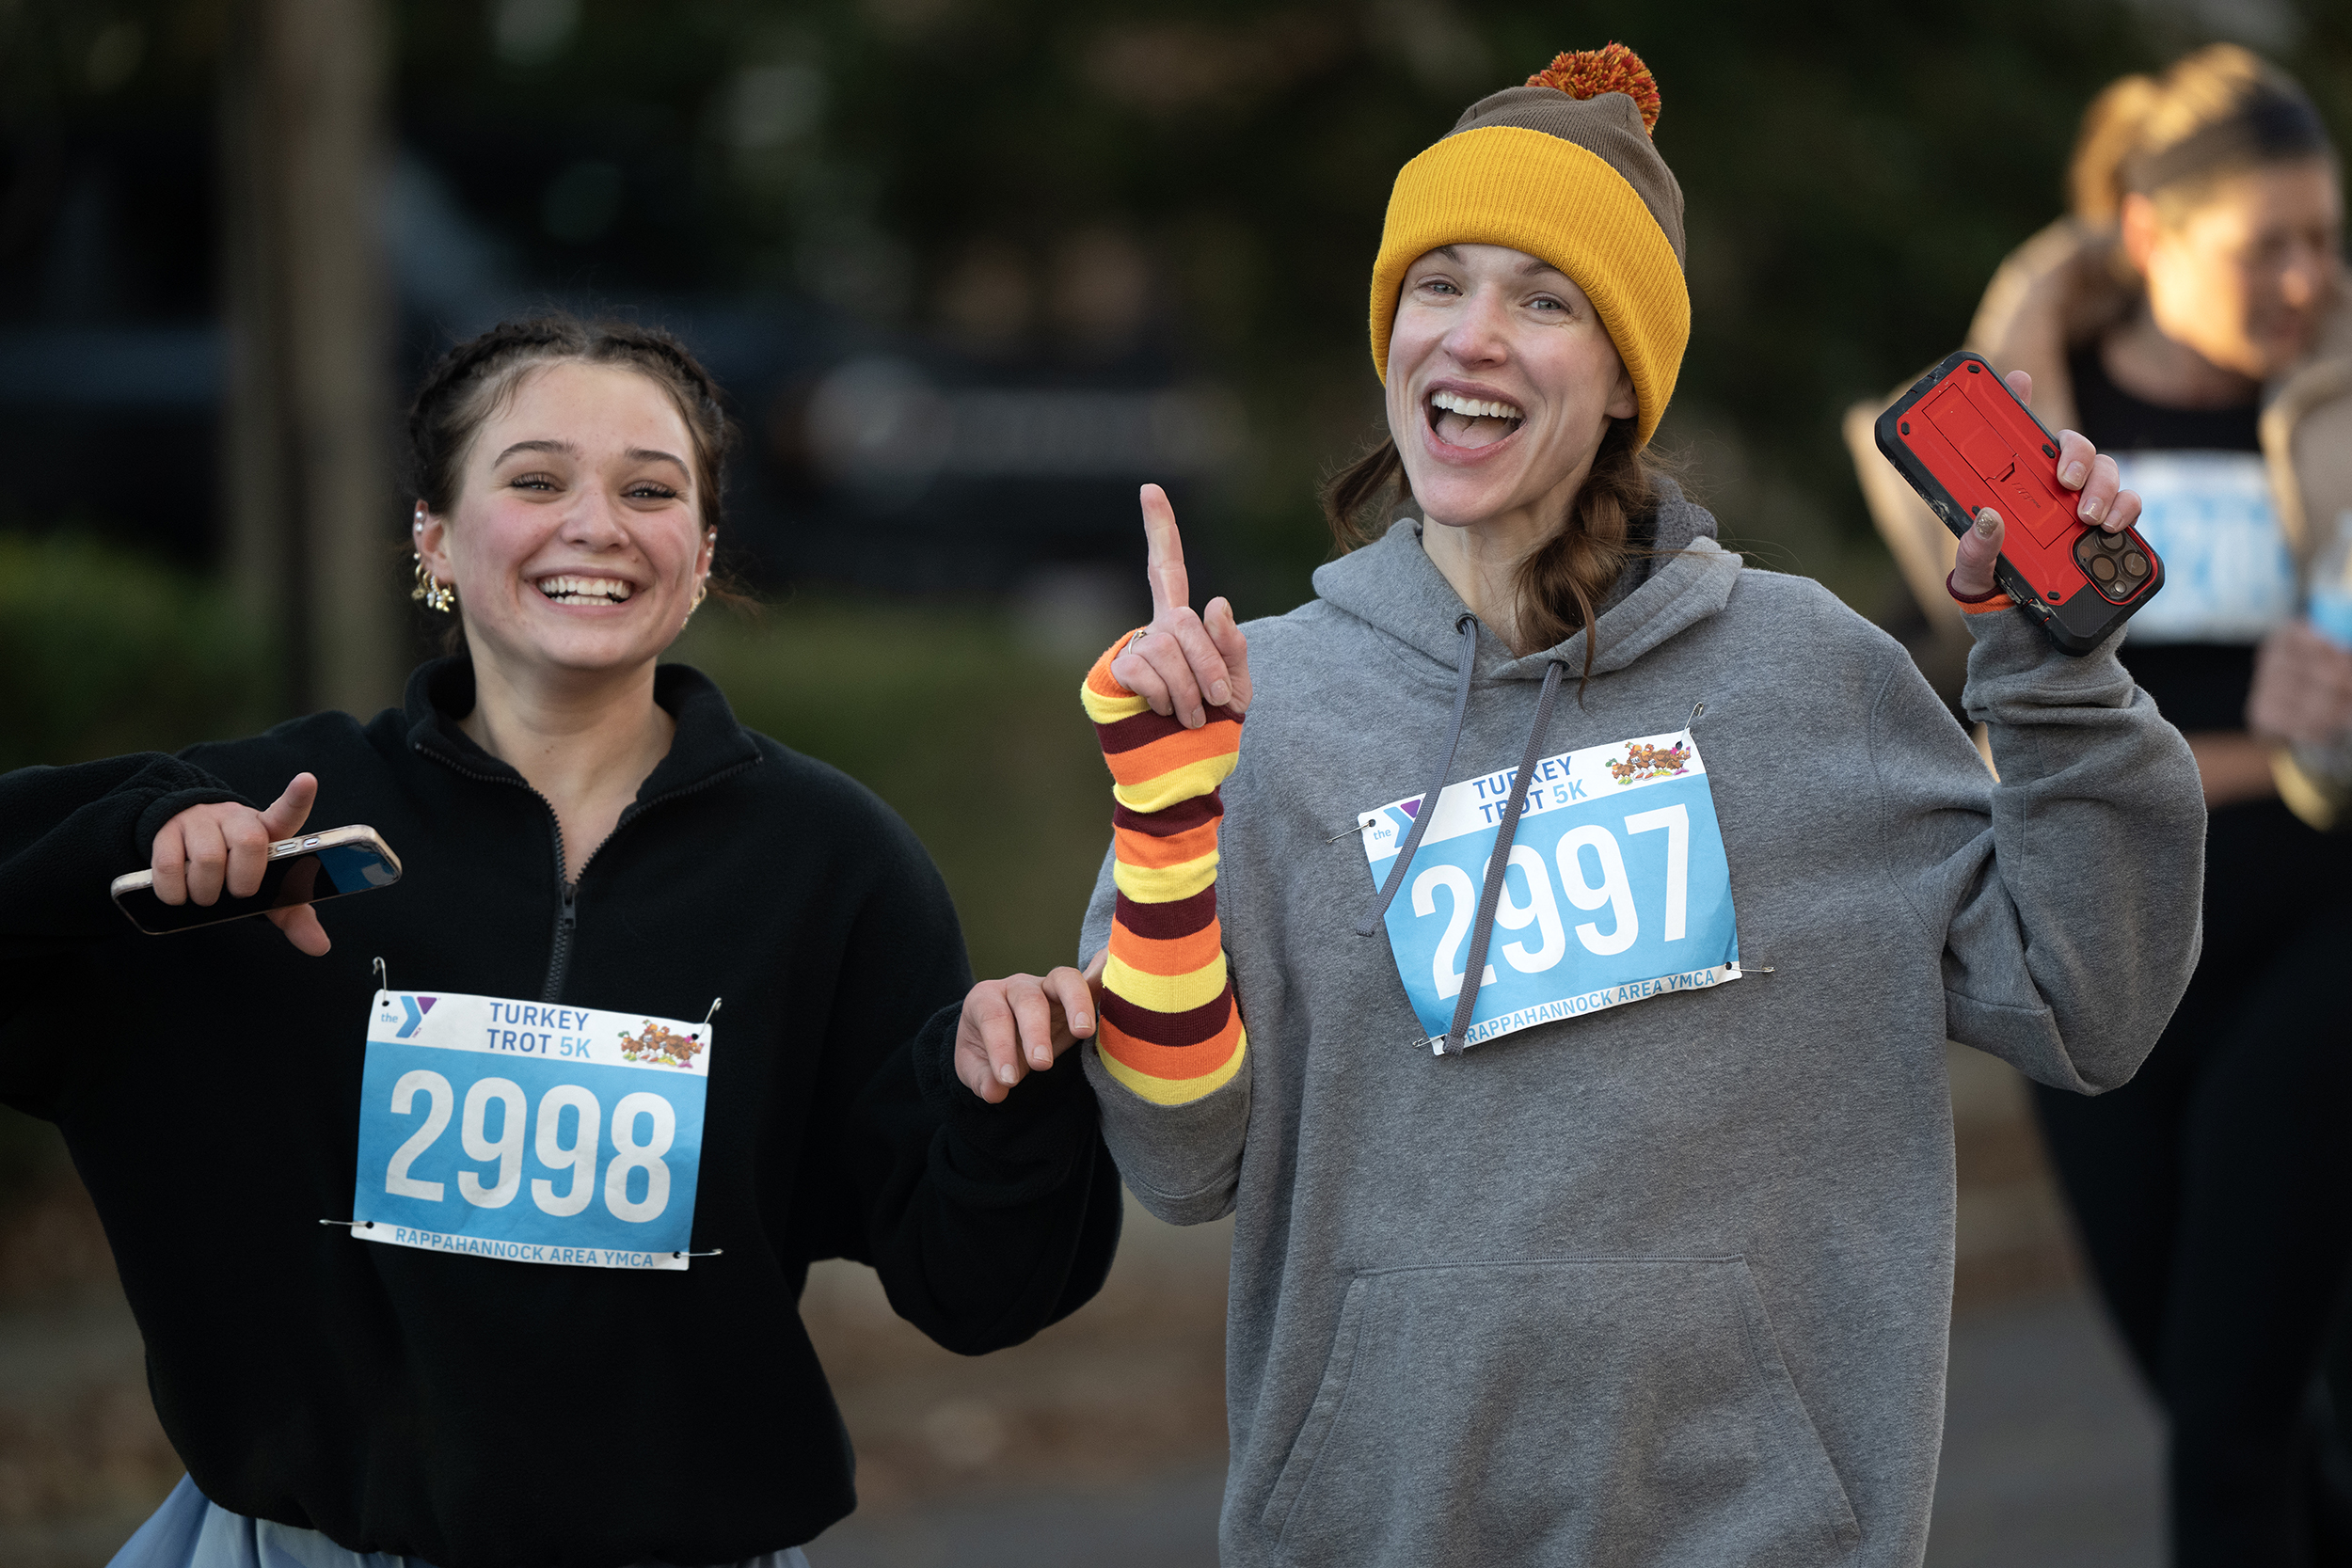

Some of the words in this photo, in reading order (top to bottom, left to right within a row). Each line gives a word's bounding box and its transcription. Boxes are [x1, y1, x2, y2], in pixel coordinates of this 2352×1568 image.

[1552, 779, 1588, 804] 5K
[1374, 828, 1391, 840] the
[1411, 803, 1689, 1000] 2997
[381, 1013, 398, 1023] the
[489, 1002, 590, 1031] TURKEY
[1467, 990, 1613, 1043] RAPPAHANNOCK
[1618, 979, 1662, 1003] AREA
[1668, 970, 1715, 990] YMCA
[486, 1029, 552, 1053] TROT
[559, 1036, 593, 1058] 5K
[385, 1070, 675, 1223] 2998
[395, 1227, 544, 1260] RAPPAHANNOCK
[549, 1249, 597, 1264] AREA
[605, 1251, 654, 1267] YMCA
